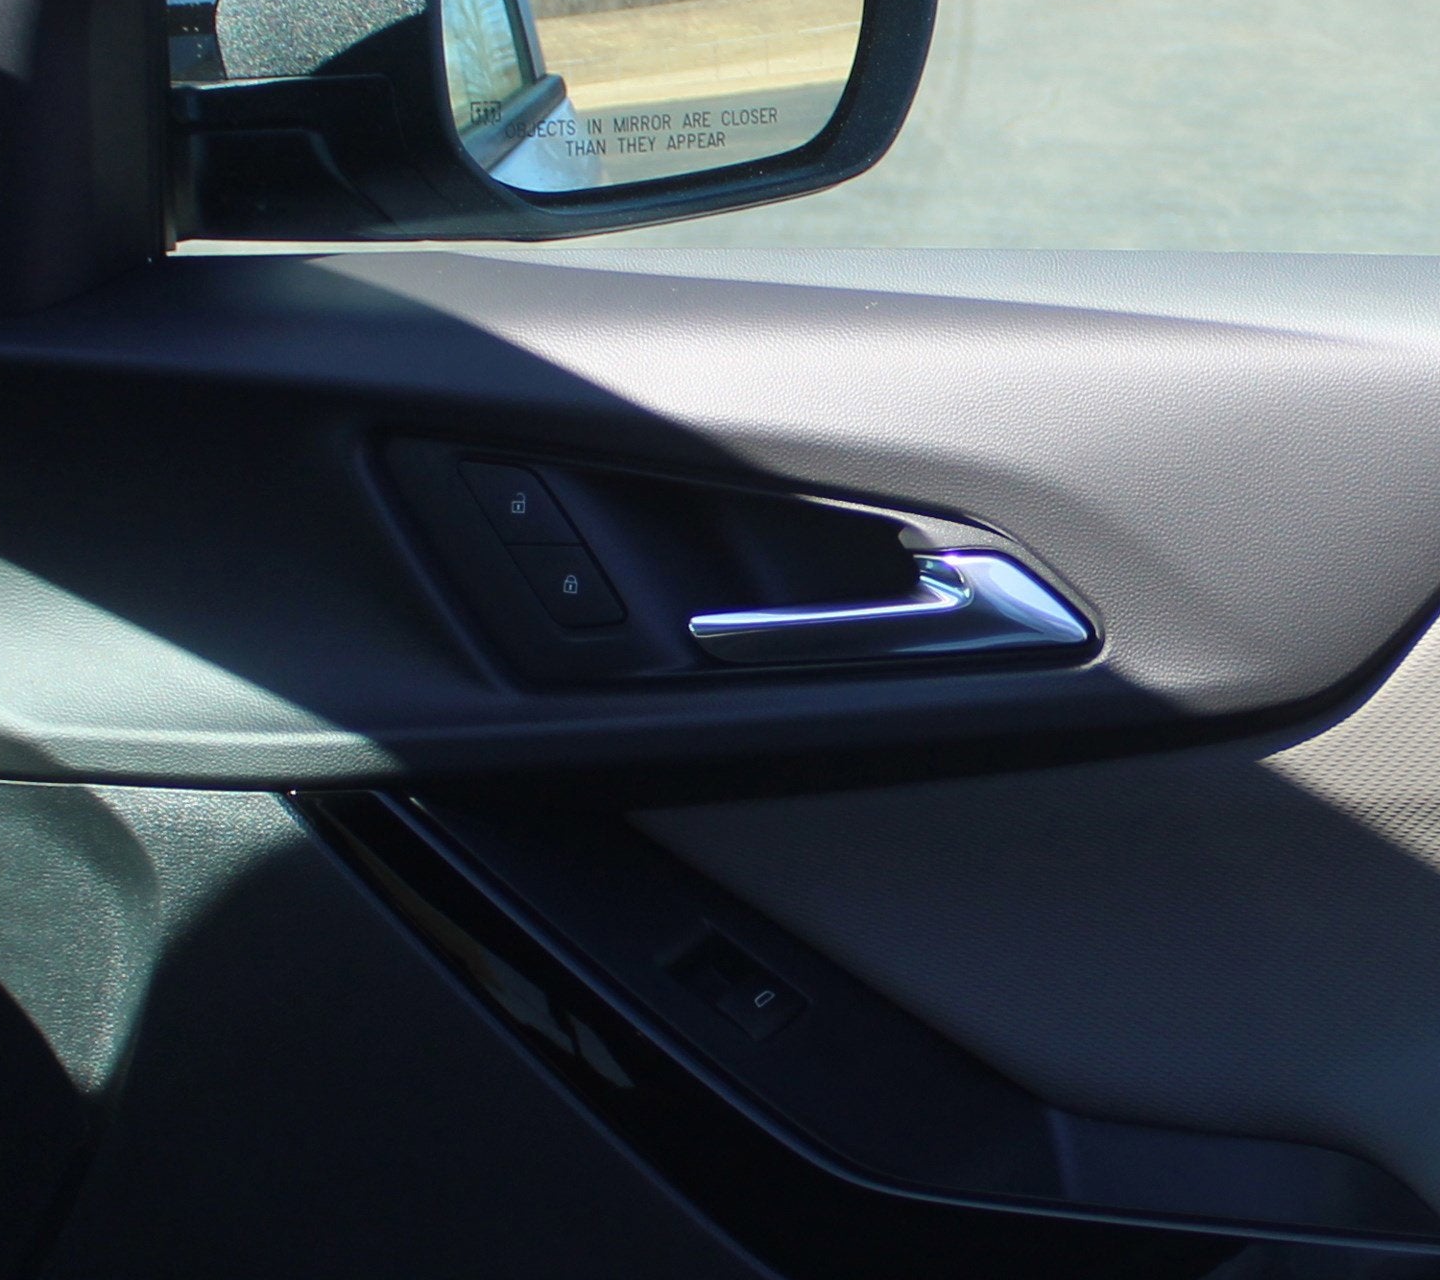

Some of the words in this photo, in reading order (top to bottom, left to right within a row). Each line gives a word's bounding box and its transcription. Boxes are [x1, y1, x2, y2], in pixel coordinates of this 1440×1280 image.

[505, 120, 576, 139] OBJECTS
[586, 118, 603, 135] IN
[613, 113, 672, 133] MIRROR
[682, 110, 712, 129] ARE
[721, 106, 778, 126] CLOSER
[565, 138, 607, 157] THAN
[617, 135, 658, 153] THEY
[666, 131, 726, 151] APPEAR
